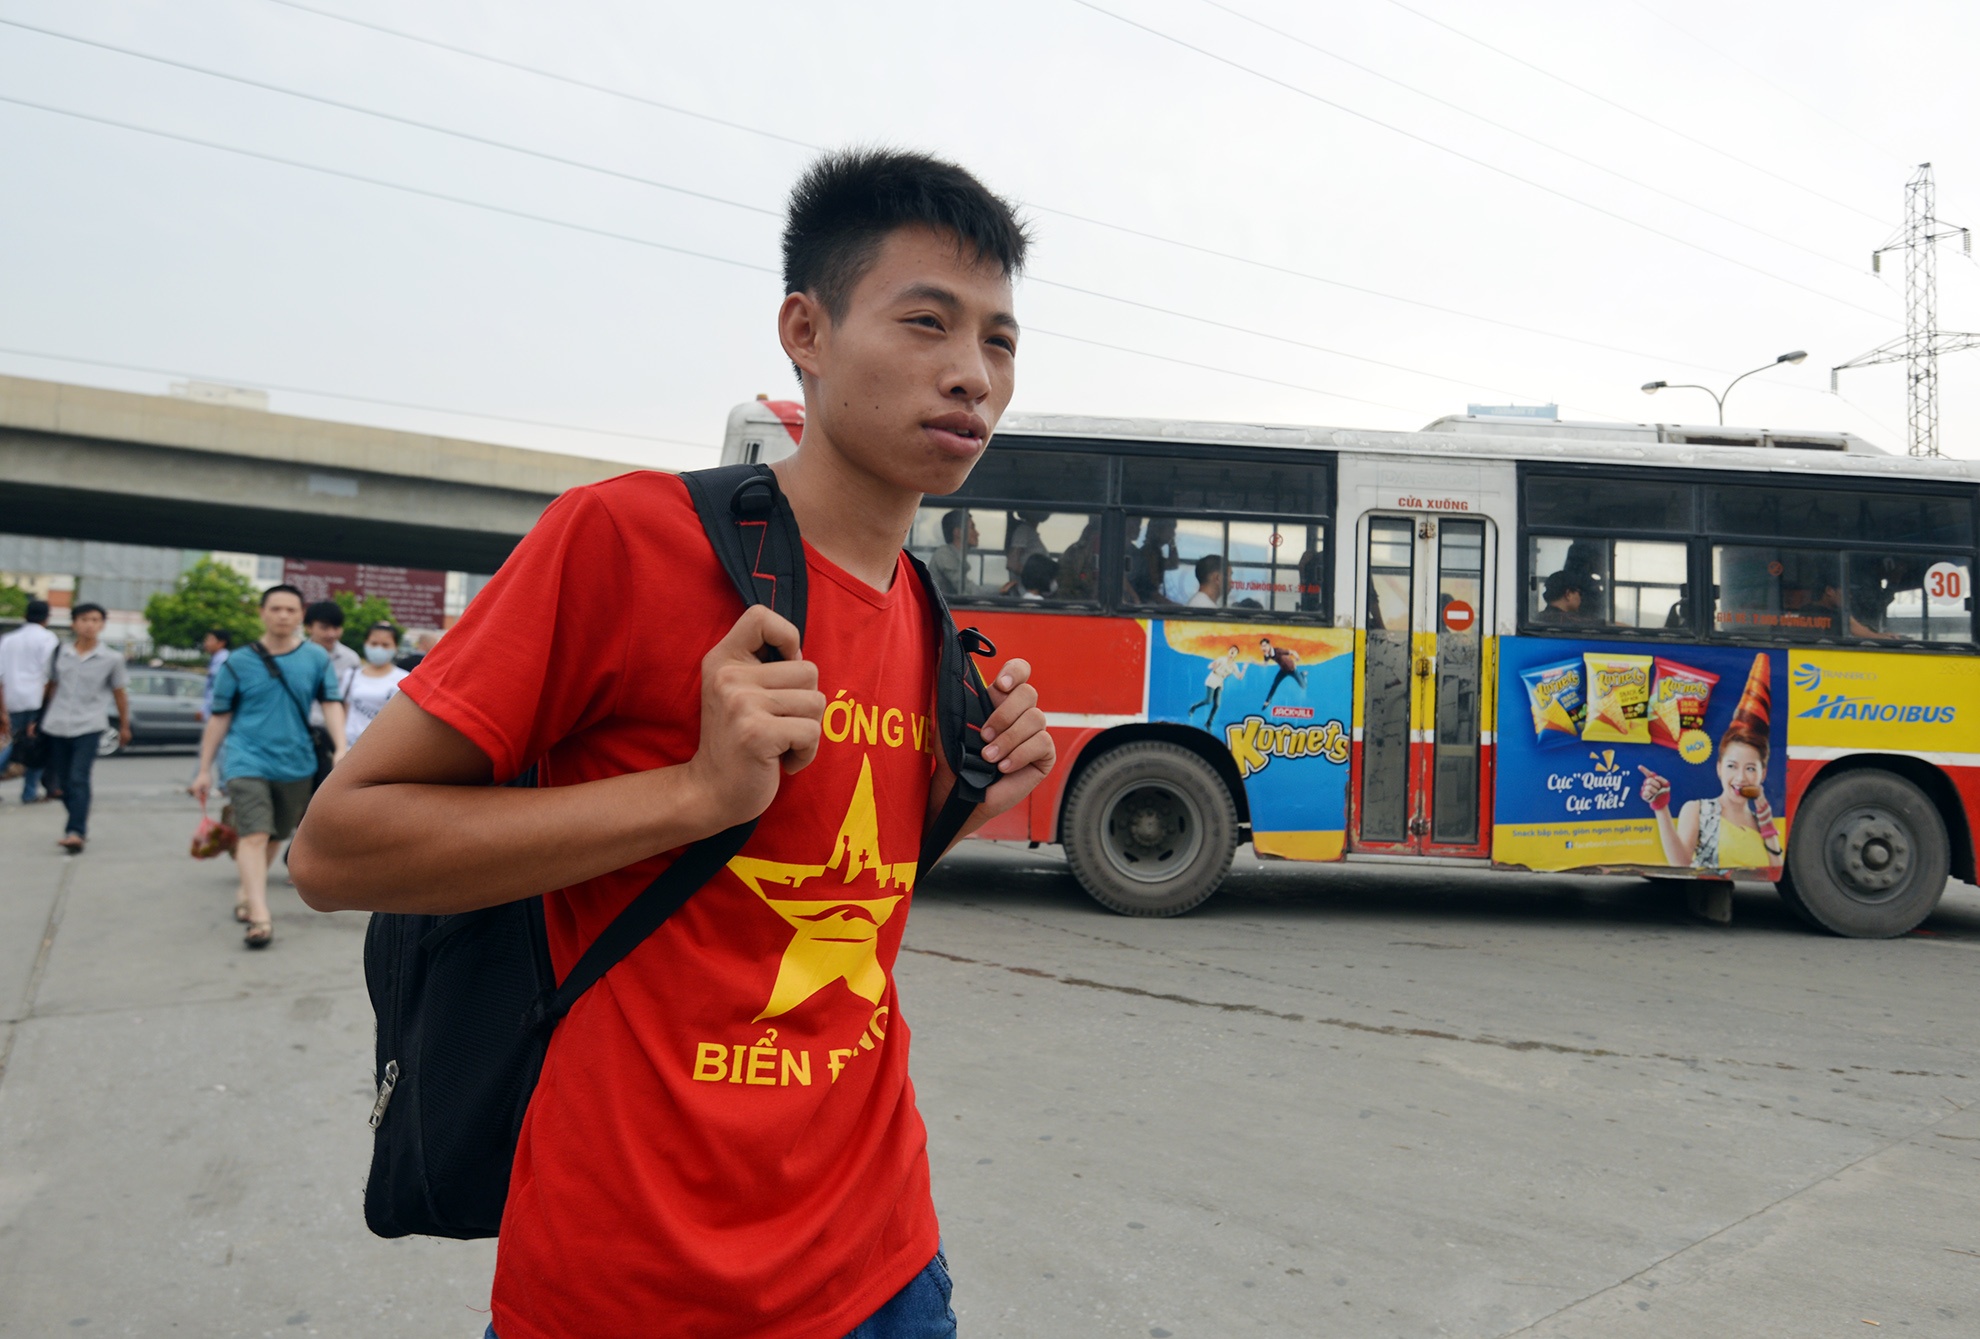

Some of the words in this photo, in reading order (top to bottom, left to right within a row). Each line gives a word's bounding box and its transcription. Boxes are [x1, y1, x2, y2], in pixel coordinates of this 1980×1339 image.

[1398, 494, 1423, 508] CỬA
[1427, 497, 1469, 510] XUỐNG
[1930, 571, 1961, 598] 30
[823, 689, 904, 748] ỚNG
[1795, 694, 1956, 723] HANOIBUS
[1228, 718, 1349, 776] Kornets
[1547, 773, 1574, 793] Cực
[1566, 795, 1592, 815] Cực
[1513, 829, 1535, 837] Snack
[1592, 827, 1612, 835] ngon
[692, 1027, 812, 1086] BIỂN
